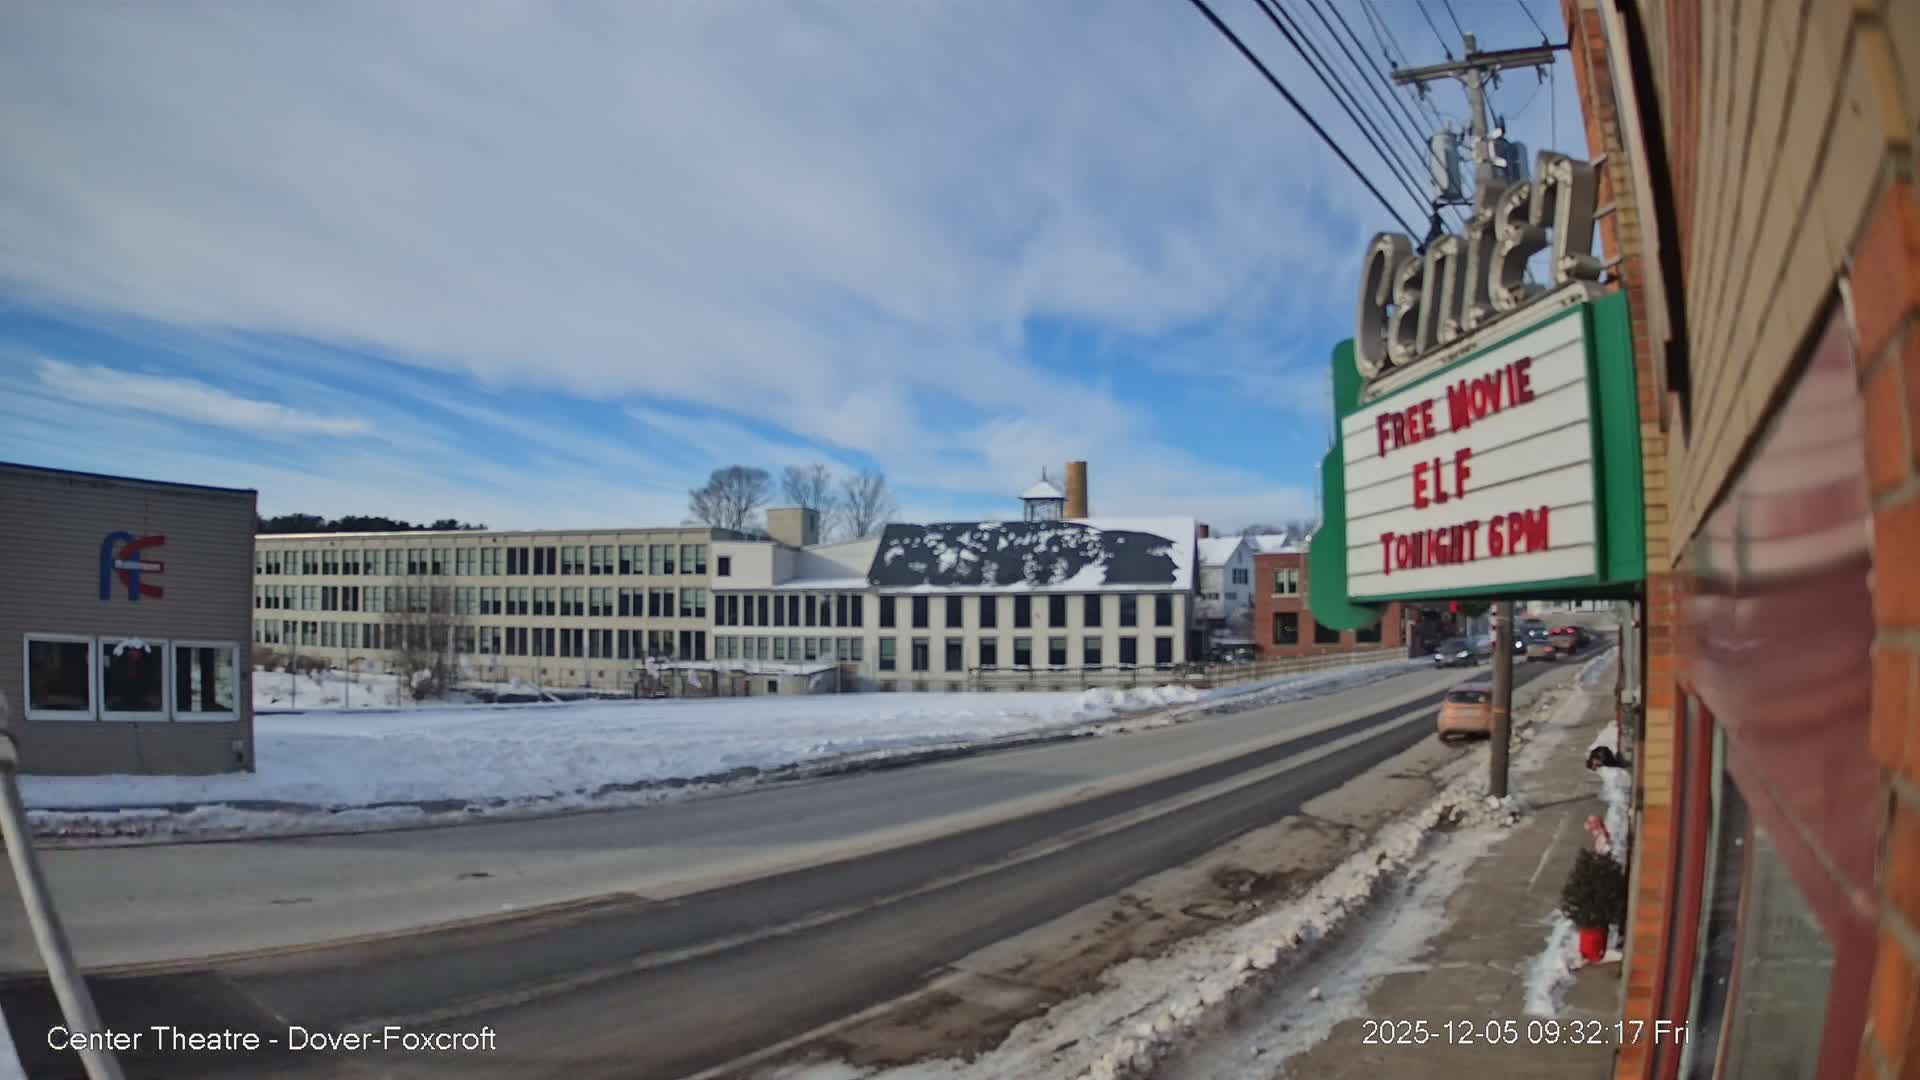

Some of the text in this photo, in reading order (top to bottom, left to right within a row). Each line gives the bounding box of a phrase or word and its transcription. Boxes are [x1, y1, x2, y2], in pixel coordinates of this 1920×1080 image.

[1377, 357, 1535, 458] FREE MOVIE
[1413, 448, 1472, 509] ELF
[1380, 505, 1549, 576] TONIGHT 6PM
